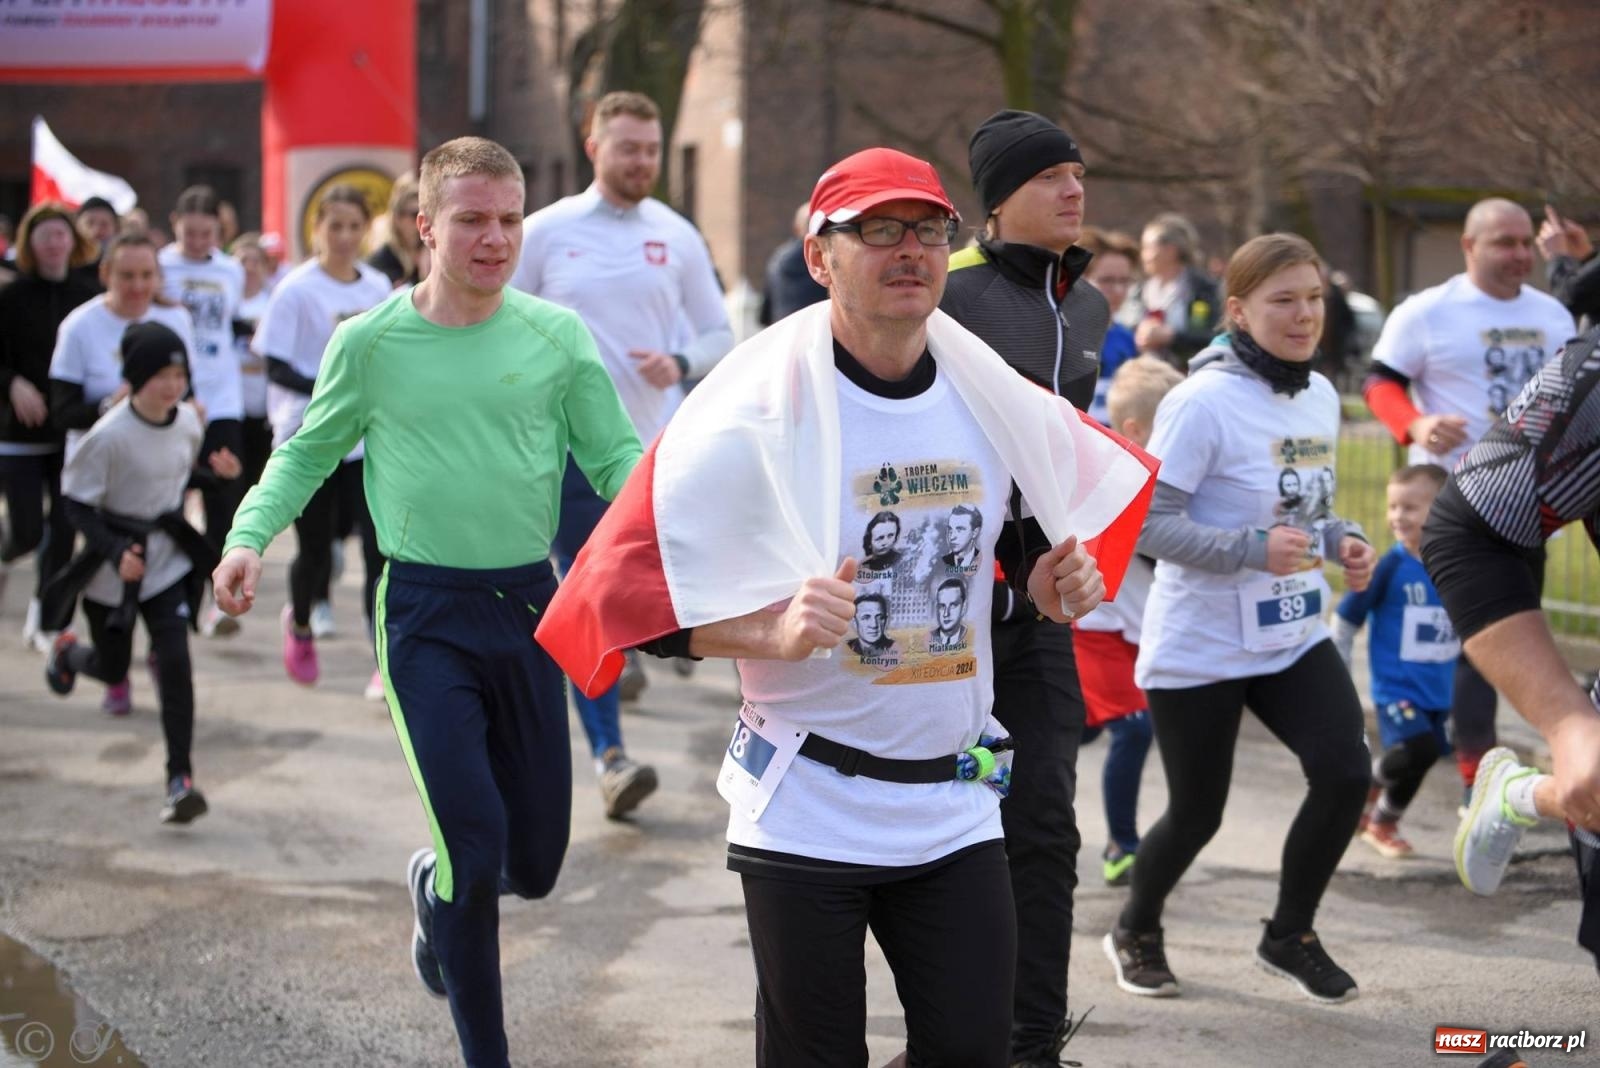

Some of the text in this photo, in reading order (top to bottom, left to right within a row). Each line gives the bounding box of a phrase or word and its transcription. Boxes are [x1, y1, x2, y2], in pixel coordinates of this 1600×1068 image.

[904, 463, 938, 477] TROPEM
[906, 473, 969, 495] WILCZYM
[857, 569, 898, 580] Stolarska
[1402, 581, 1427, 605] 10
[1279, 595, 1306, 621] 89
[860, 655, 898, 667] Kontrym
[955, 660, 973, 675] 2024
